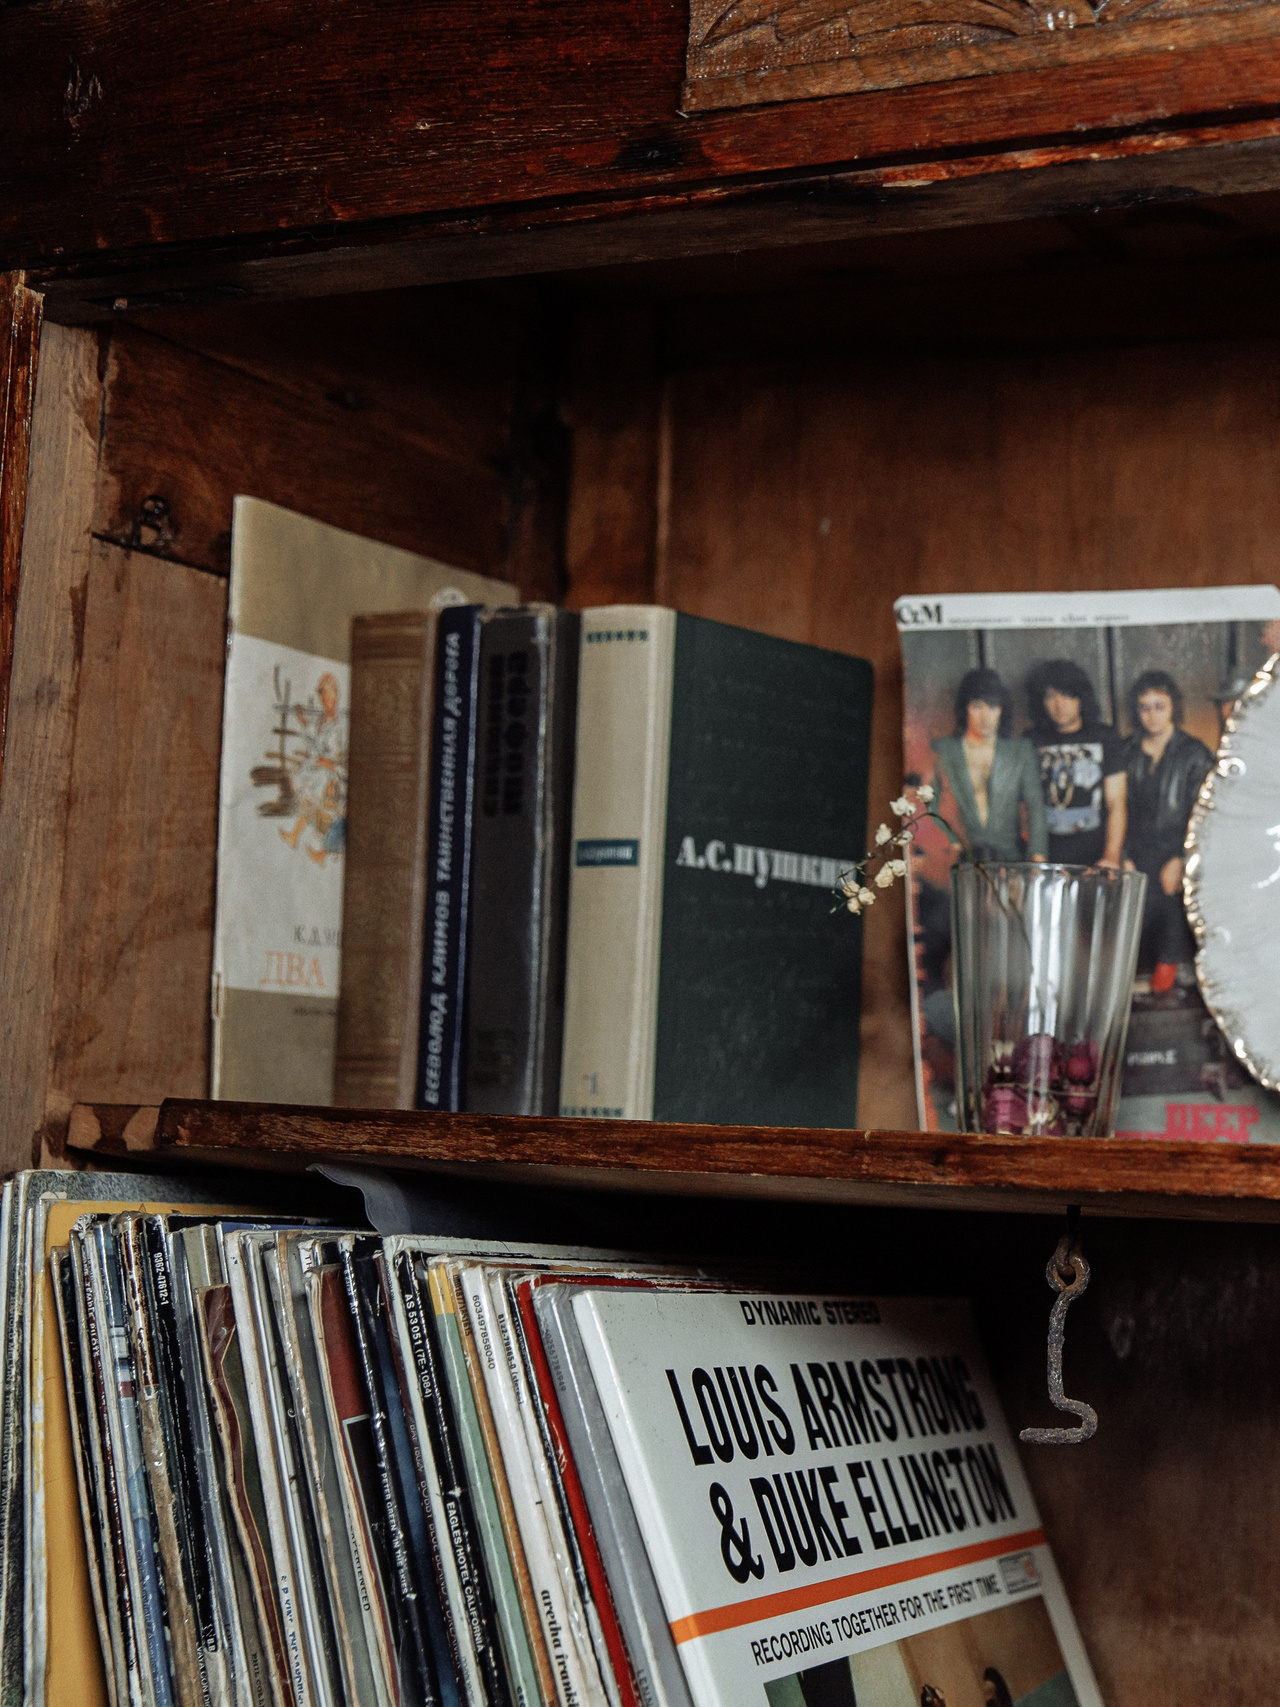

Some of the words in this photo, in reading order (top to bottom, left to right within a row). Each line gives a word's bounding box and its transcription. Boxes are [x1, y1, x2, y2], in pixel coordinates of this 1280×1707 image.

[430, 891, 450, 986] КЛИМОВ
[442, 633, 465, 717] ДОРОГА
[260, 950, 325, 988] ДВА
[1165, 1103, 1260, 1140] DEEP
[152, 1251, 169, 1305] 9362-47612-1
[471, 1294, 496, 1370] 603497858040
[740, 1301, 822, 1326] DYNAMIC
[824, 1301, 882, 1325] STEREO
[403, 1293, 414, 1309] AS
[414, 1347, 432, 1398] (7E-1084)
[497, 1313, 516, 1369] 8122-79865-0
[539, 1317, 567, 1392] 602567284949
[666, 1364, 796, 1466] LOUIS
[790, 1355, 986, 1451] ARMSTRONG
[380, 1472, 392, 1500] PETER
[385, 1501, 397, 1531] GREEN
[709, 1482, 765, 1584] &
[750, 1466, 863, 1573] DUKE
[847, 1443, 1018, 1550] ELLINGTON
[392, 1538, 400, 1548] IN
[393, 1548, 403, 1567] THE
[397, 1567, 408, 1594] SKIES
[445, 1501, 470, 1584] EAGLES/HOTEL
[464, 1585, 484, 1652] CALIFORNIA
[540, 1588, 565, 1649] aretha
[751, 1622, 834, 1666] RECORDING
[832, 1602, 901, 1640] TOGETHER
[900, 1595, 926, 1622] FOR
[926, 1587, 949, 1613] THE
[948, 1578, 975, 1605] FIRST
[974, 1574, 1002, 1595] TIME
[195, 1645, 205, 1670] VAYA
[251, 1652, 260, 1677] PHIL
[199, 1670, 208, 1692] CON
